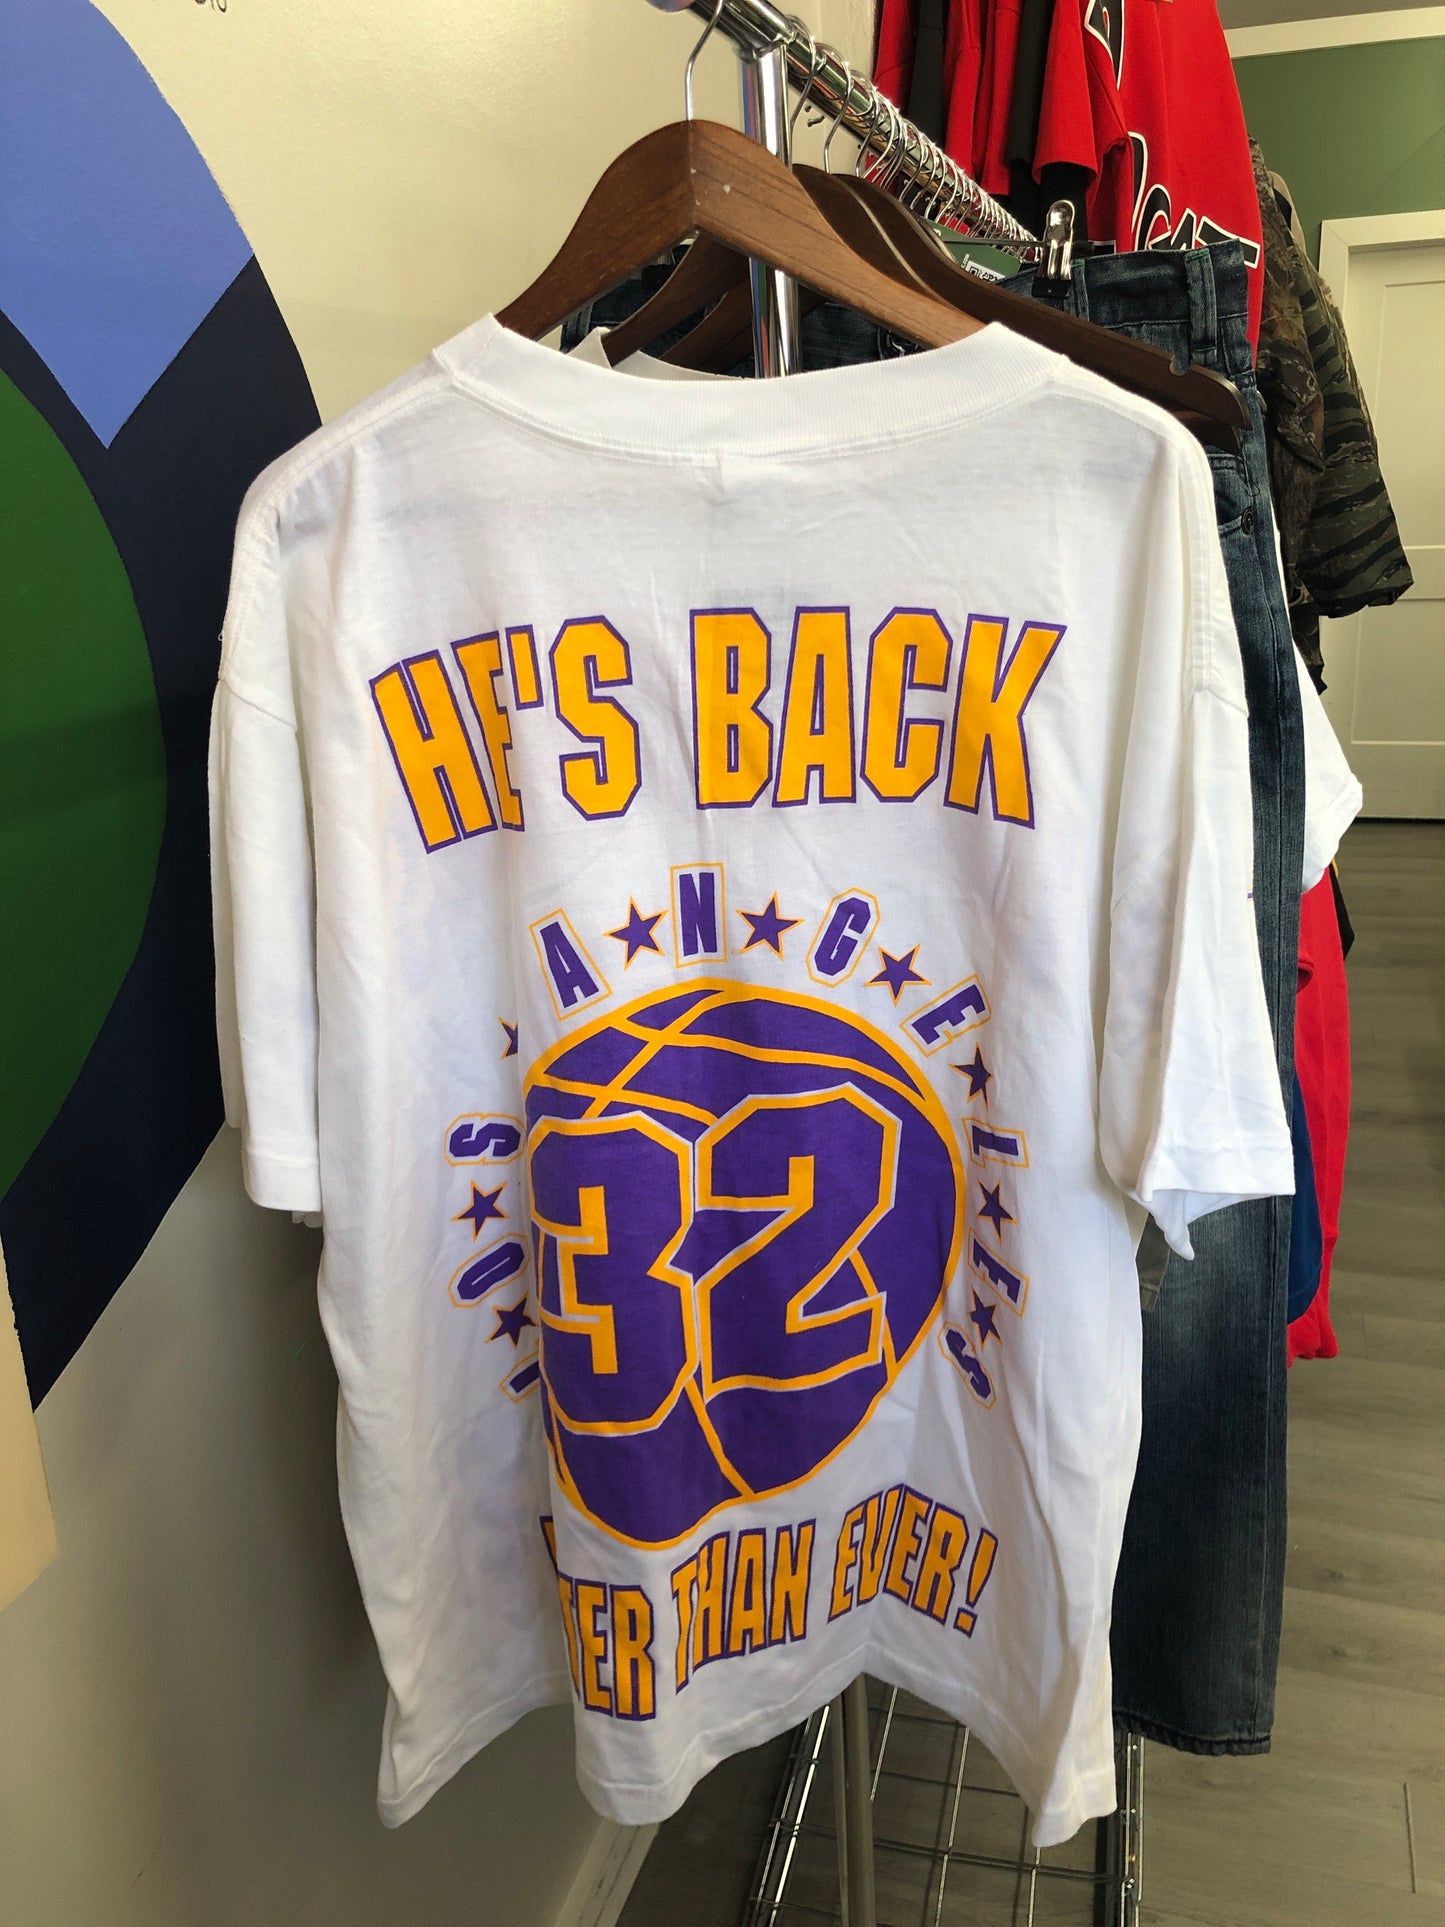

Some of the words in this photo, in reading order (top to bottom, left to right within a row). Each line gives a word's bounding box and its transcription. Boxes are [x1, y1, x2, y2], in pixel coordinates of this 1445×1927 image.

[369, 615, 642, 853] HE'S
[689, 606, 1067, 829] BACK
[527, 1081, 903, 1436] 32
[529, 862, 1030, 1410] ANGELES
[671, 1518, 816, 1694] THAN
[827, 1483, 998, 1638] EVER!
